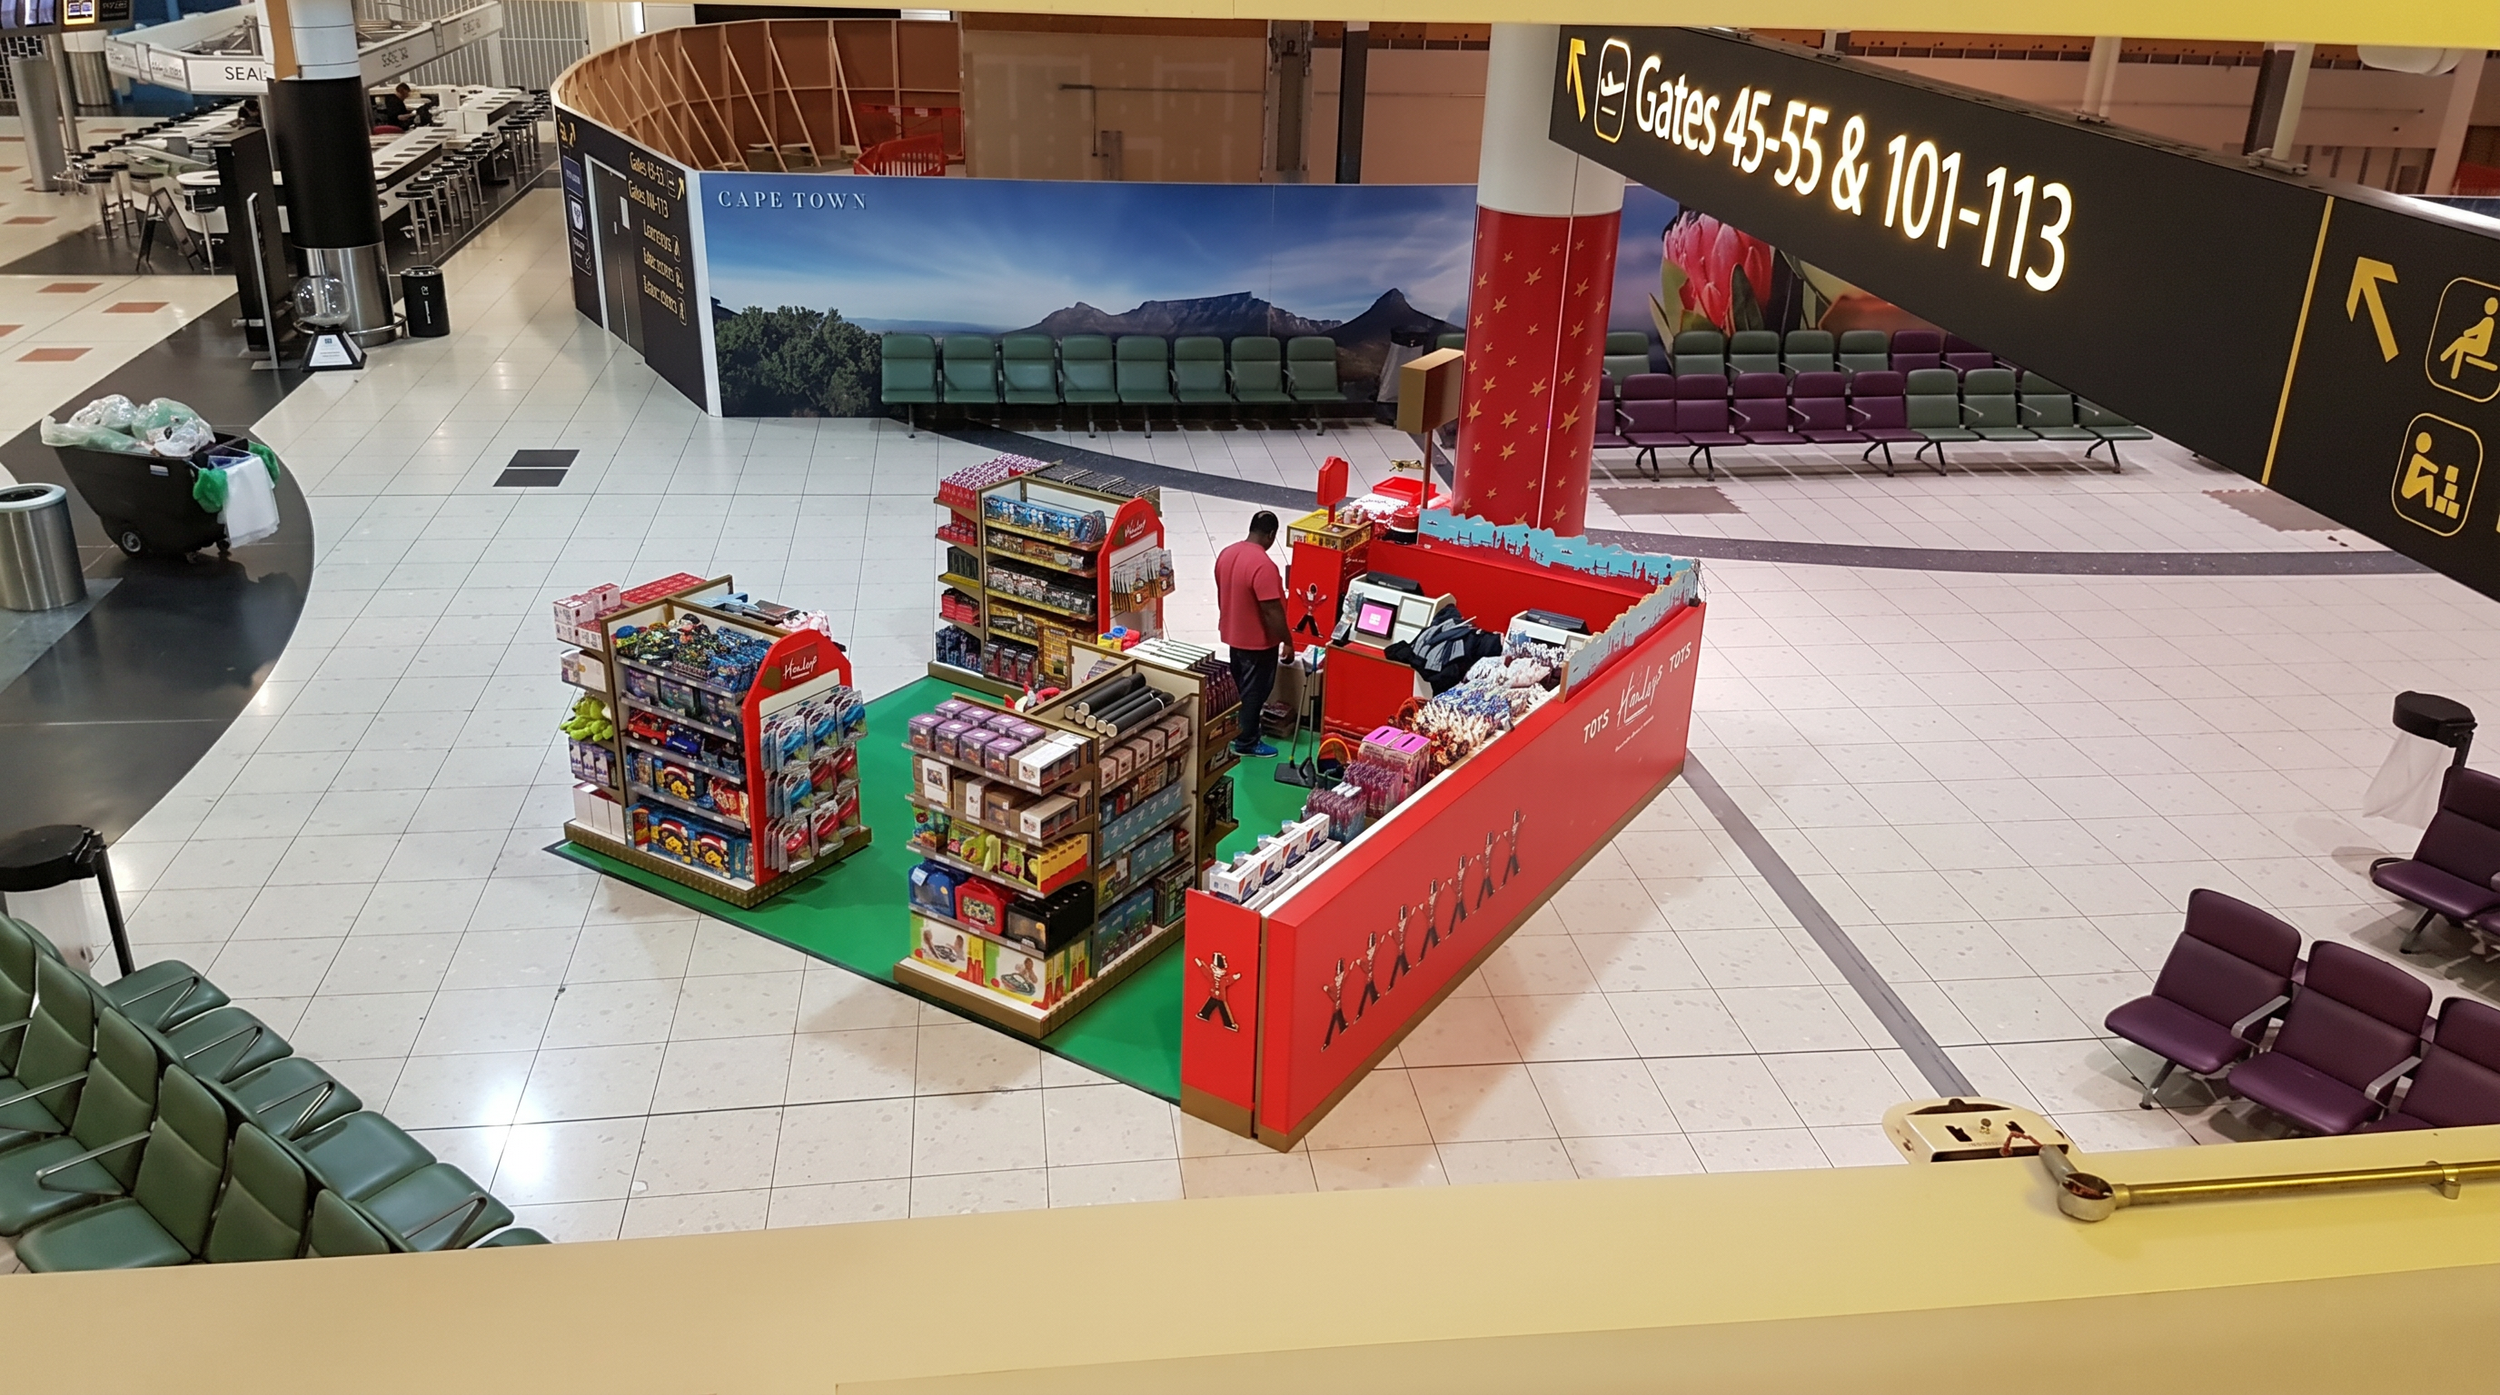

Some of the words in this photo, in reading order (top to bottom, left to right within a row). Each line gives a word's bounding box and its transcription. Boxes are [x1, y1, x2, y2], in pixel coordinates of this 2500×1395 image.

[717, 190, 784, 209] CAPE
[792, 192, 867, 210] TOWN
[1635, 54, 1721, 158] Gates
[1723, 86, 1829, 197] 45-55
[1831, 114, 1873, 217] &
[1883, 133, 2075, 293] 101-113
[1583, 708, 1610, 744] TOTS
[1669, 641, 1692, 673] TOTS
